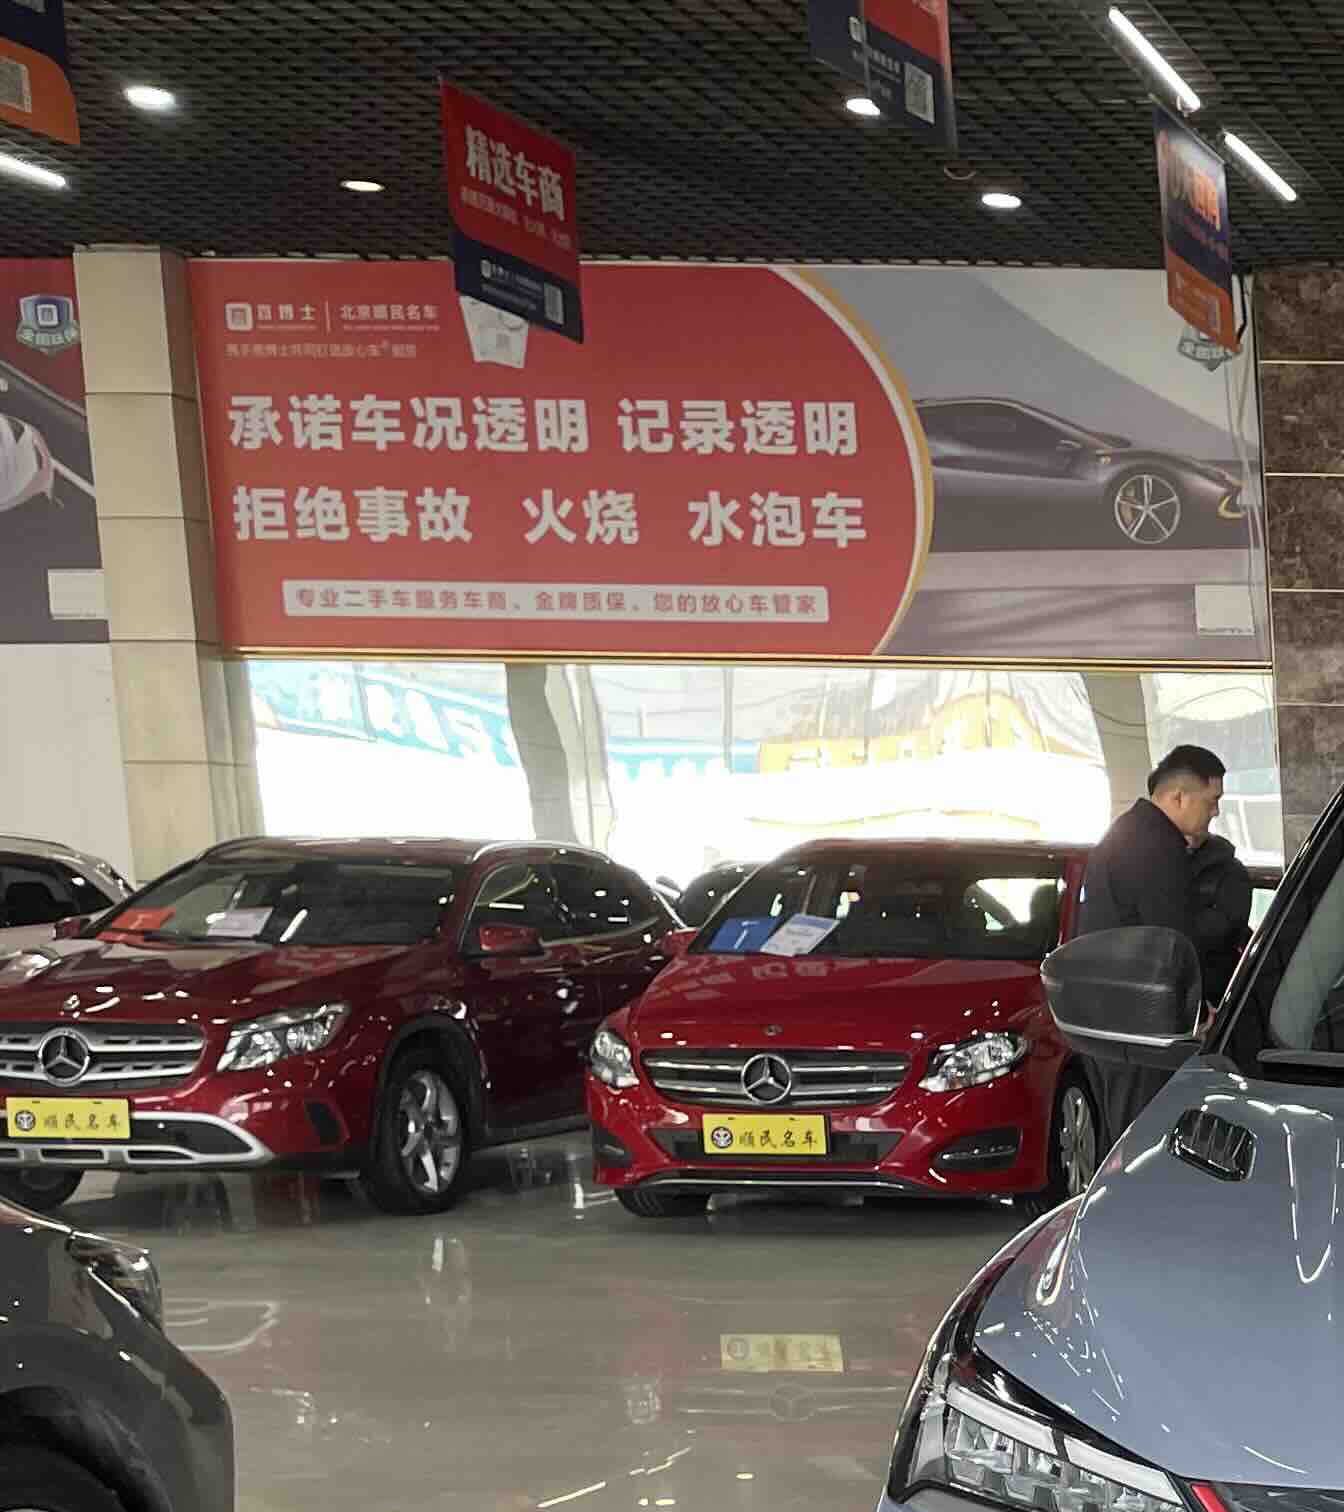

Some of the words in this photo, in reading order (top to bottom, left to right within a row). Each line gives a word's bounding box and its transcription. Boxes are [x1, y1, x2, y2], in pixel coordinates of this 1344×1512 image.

[464, 124, 565, 222] 精选车商
[228, 394, 590, 453] 承诺车况透明
[617, 398, 858, 456] 记录透明
[232, 486, 473, 543] 拒绝事故
[521, 489, 640, 545] 火烧
[687, 490, 867, 549] 水泡车
